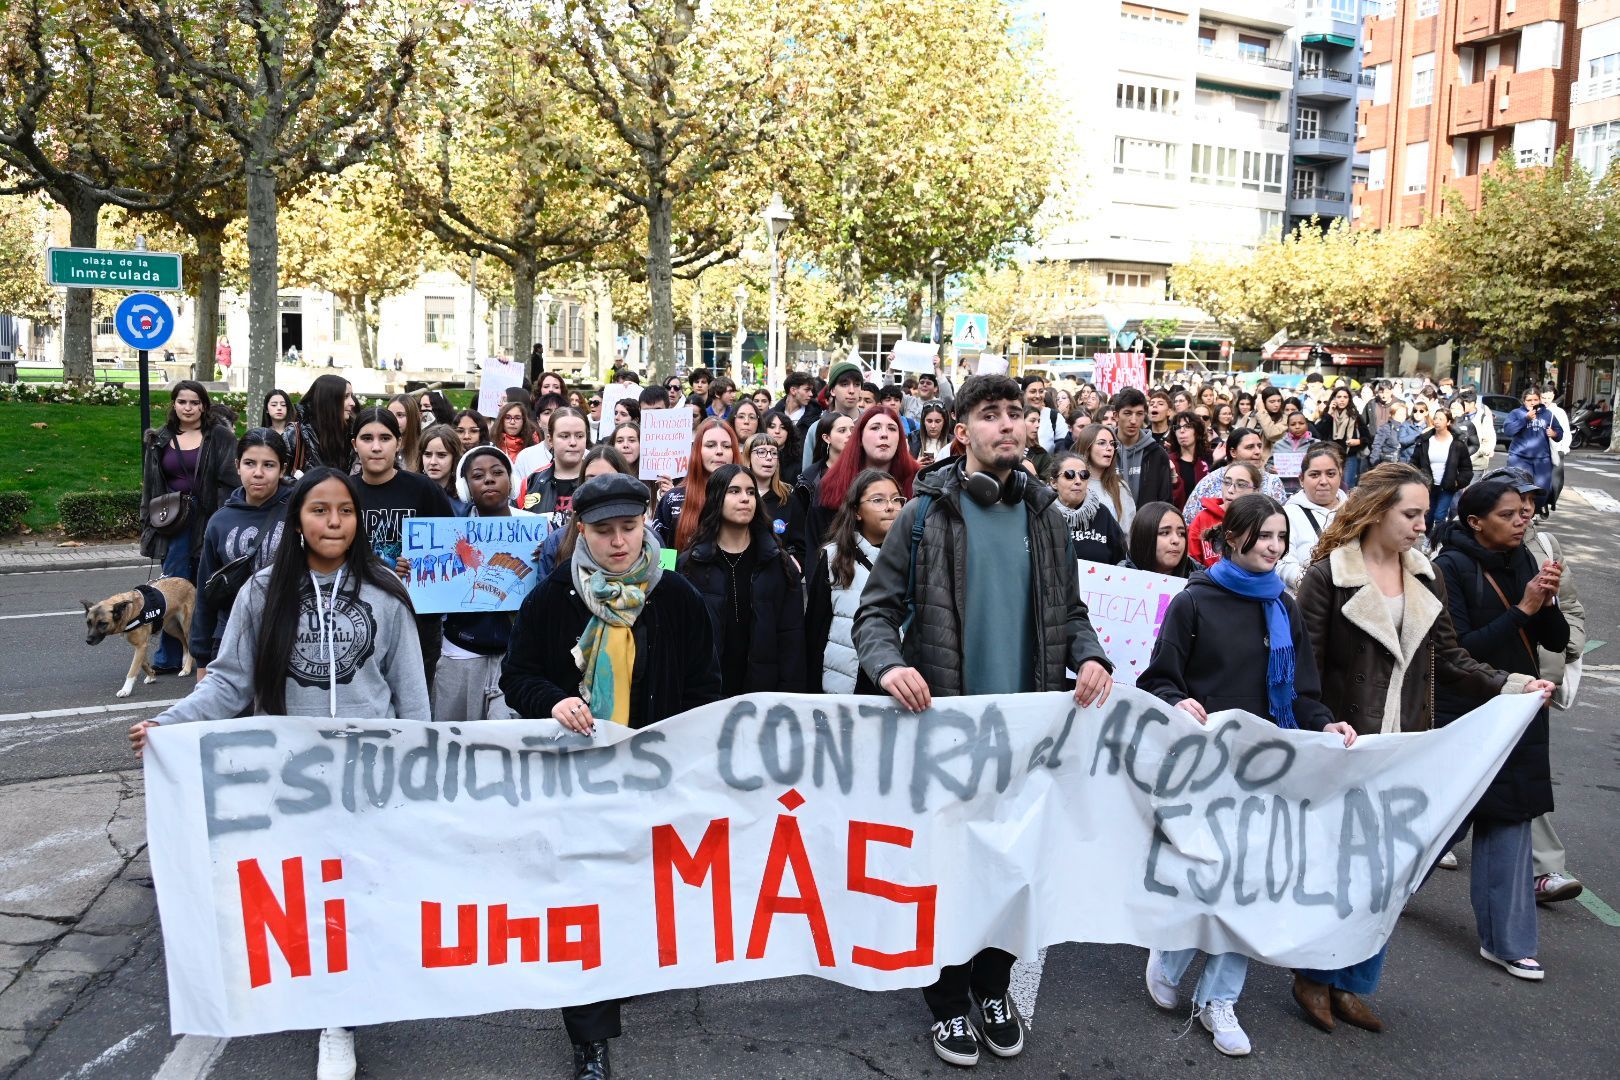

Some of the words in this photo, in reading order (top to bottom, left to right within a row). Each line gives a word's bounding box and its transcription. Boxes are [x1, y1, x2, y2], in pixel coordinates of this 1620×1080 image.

[71, 266, 160, 281] Inmaculada
[119, 258, 133, 267] de
[138, 259, 149, 268] la
[675, 456, 688, 474] YA
[408, 521, 444, 550] EL
[406, 553, 466, 585] MATA
[717, 700, 1012, 814] CONTRA
[1028, 707, 1077, 773] el
[1090, 699, 1297, 798] ACOSO
[1144, 784, 1430, 920] ESCOLAR
[238, 856, 348, 989] Ni
[421, 900, 601, 971] una
[652, 788, 937, 971] MÁS
